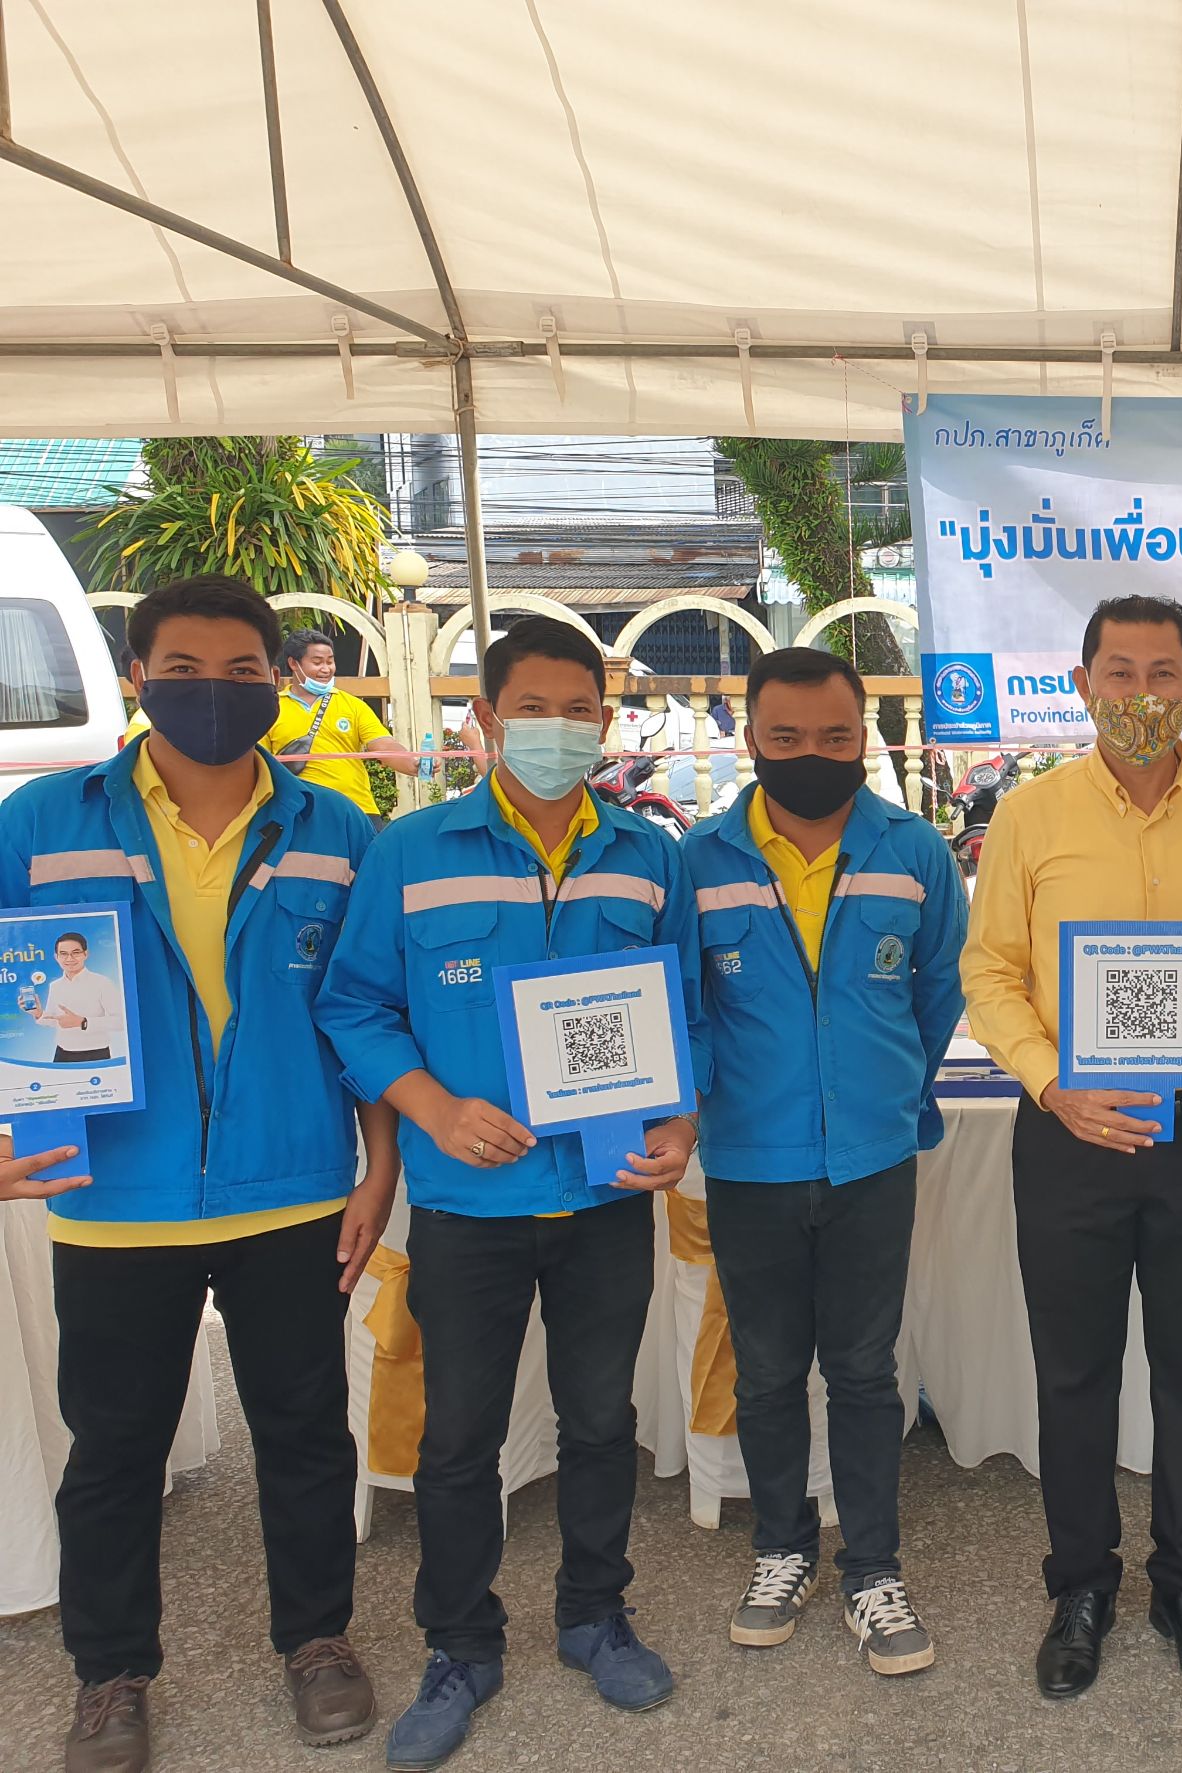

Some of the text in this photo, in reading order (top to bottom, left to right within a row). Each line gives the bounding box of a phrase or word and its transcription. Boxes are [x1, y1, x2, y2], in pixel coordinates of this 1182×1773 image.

[1010, 707, 1088, 724] Provincial
[1083, 945, 1099, 956] QR
[1100, 944, 1126, 955] Code
[460, 958, 481, 968] LINE
[438, 967, 482, 985] 1662
[875, 1577, 896, 1586] adida
